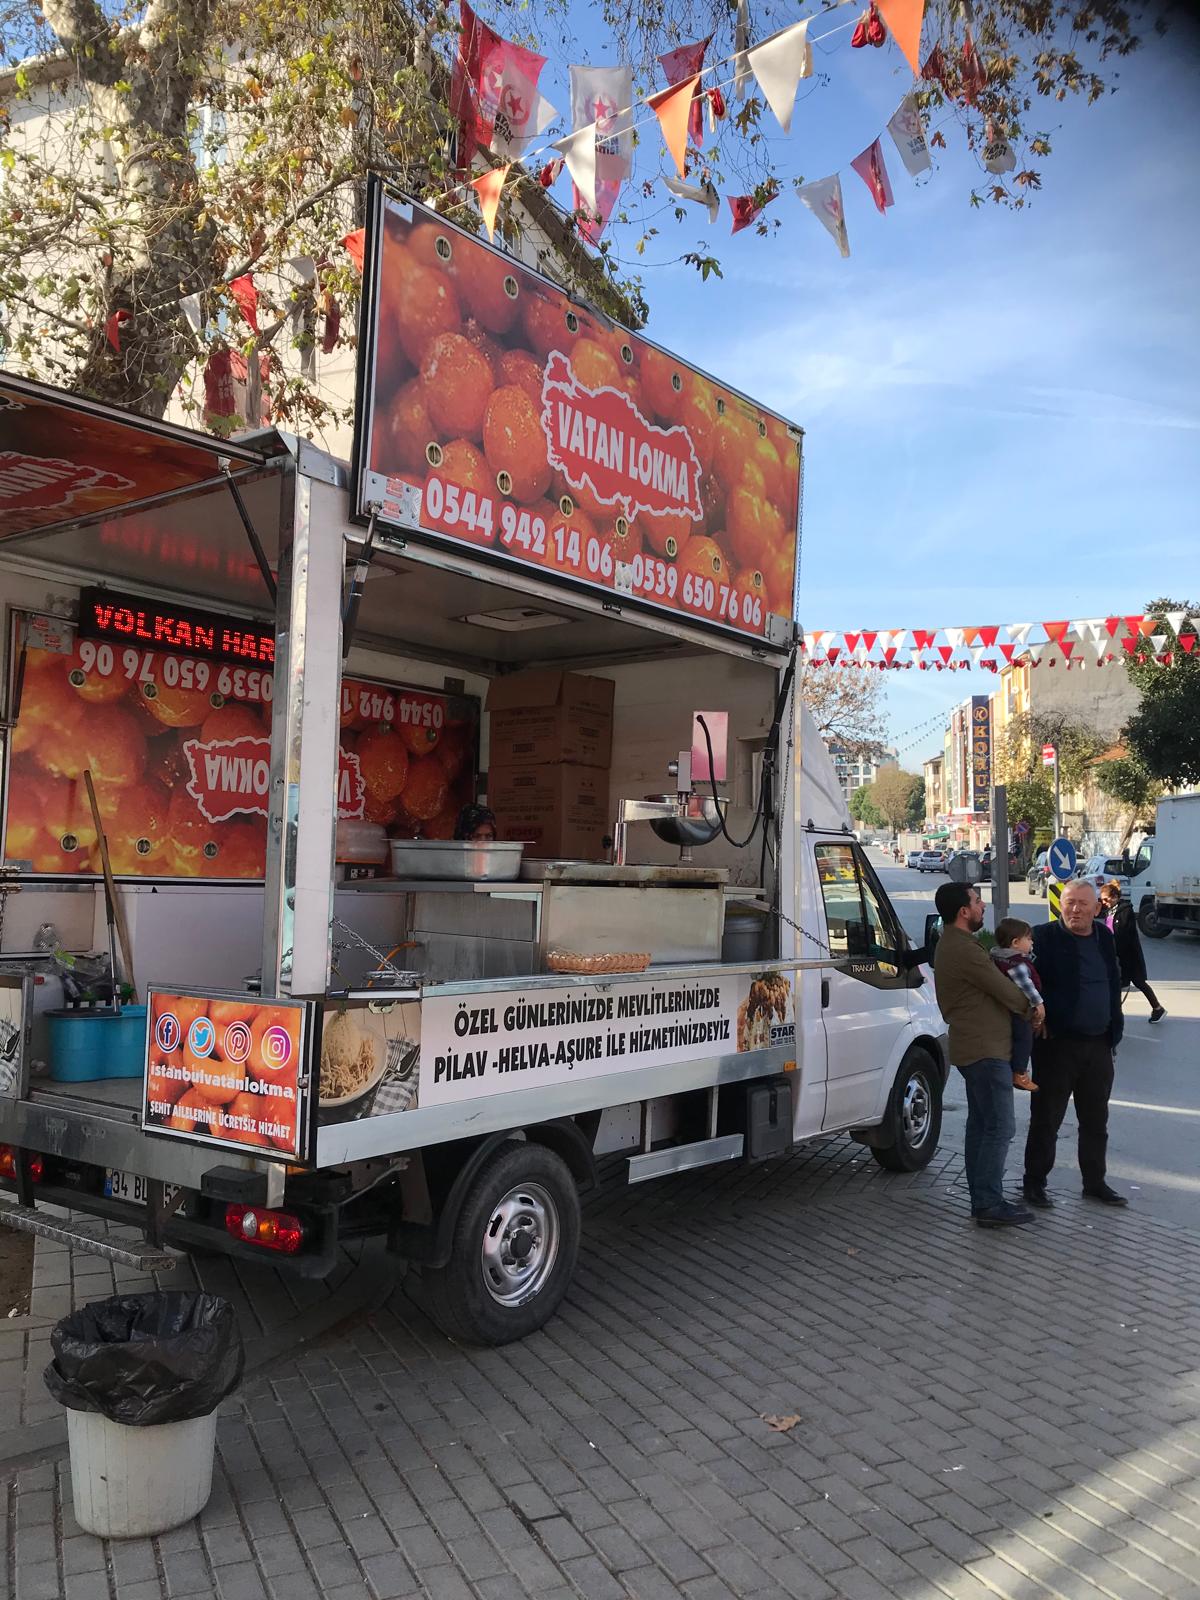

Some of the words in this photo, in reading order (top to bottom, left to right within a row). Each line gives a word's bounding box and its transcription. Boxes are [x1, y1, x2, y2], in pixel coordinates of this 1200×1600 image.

[558, 402, 625, 474] VATAN
[630, 441, 690, 503] LOKMA
[427, 477, 493, 536] 0544
[501, 511, 546, 555] 942
[554, 528, 581, 566] 14
[587, 540, 613, 578] 06
[632, 554, 678, 598] 0539
[683, 574, 715, 612] 650
[719, 586, 738, 620] 76
[743, 597, 761, 627] 06
[94, 604, 215, 651] VOLKAN
[79, 642, 114, 676] 06
[123, 650, 155, 682] 76
[163, 658, 209, 689] 650
[217, 669, 274, 701] 0539
[360, 689, 395, 721] 942
[400, 699, 444, 729] 0544
[204, 753, 271, 795] OKMA
[454, 1003, 499, 1038] ÖZEL
[503, 992, 614, 1032] GÜNLERİNİZDE
[618, 983, 721, 1019] MEVLİTLERİNİZDE
[434, 1046, 488, 1083] PİLAV
[605, 1026, 626, 1057] İLE
[629, 1014, 731, 1053] HİZMETİNİZDEYİZ
[770, 1025, 795, 1039] STAR
[150, 1061, 295, 1098] istanbulvatanlokma
[150, 1099, 171, 1117] ŞEHİT
[219, 1109, 257, 1133] ÜCRETSİZ
[258, 1117, 291, 1140] HİZMET
[112, 1170, 129, 1197] 34
[134, 1175, 148, 1202] BL
